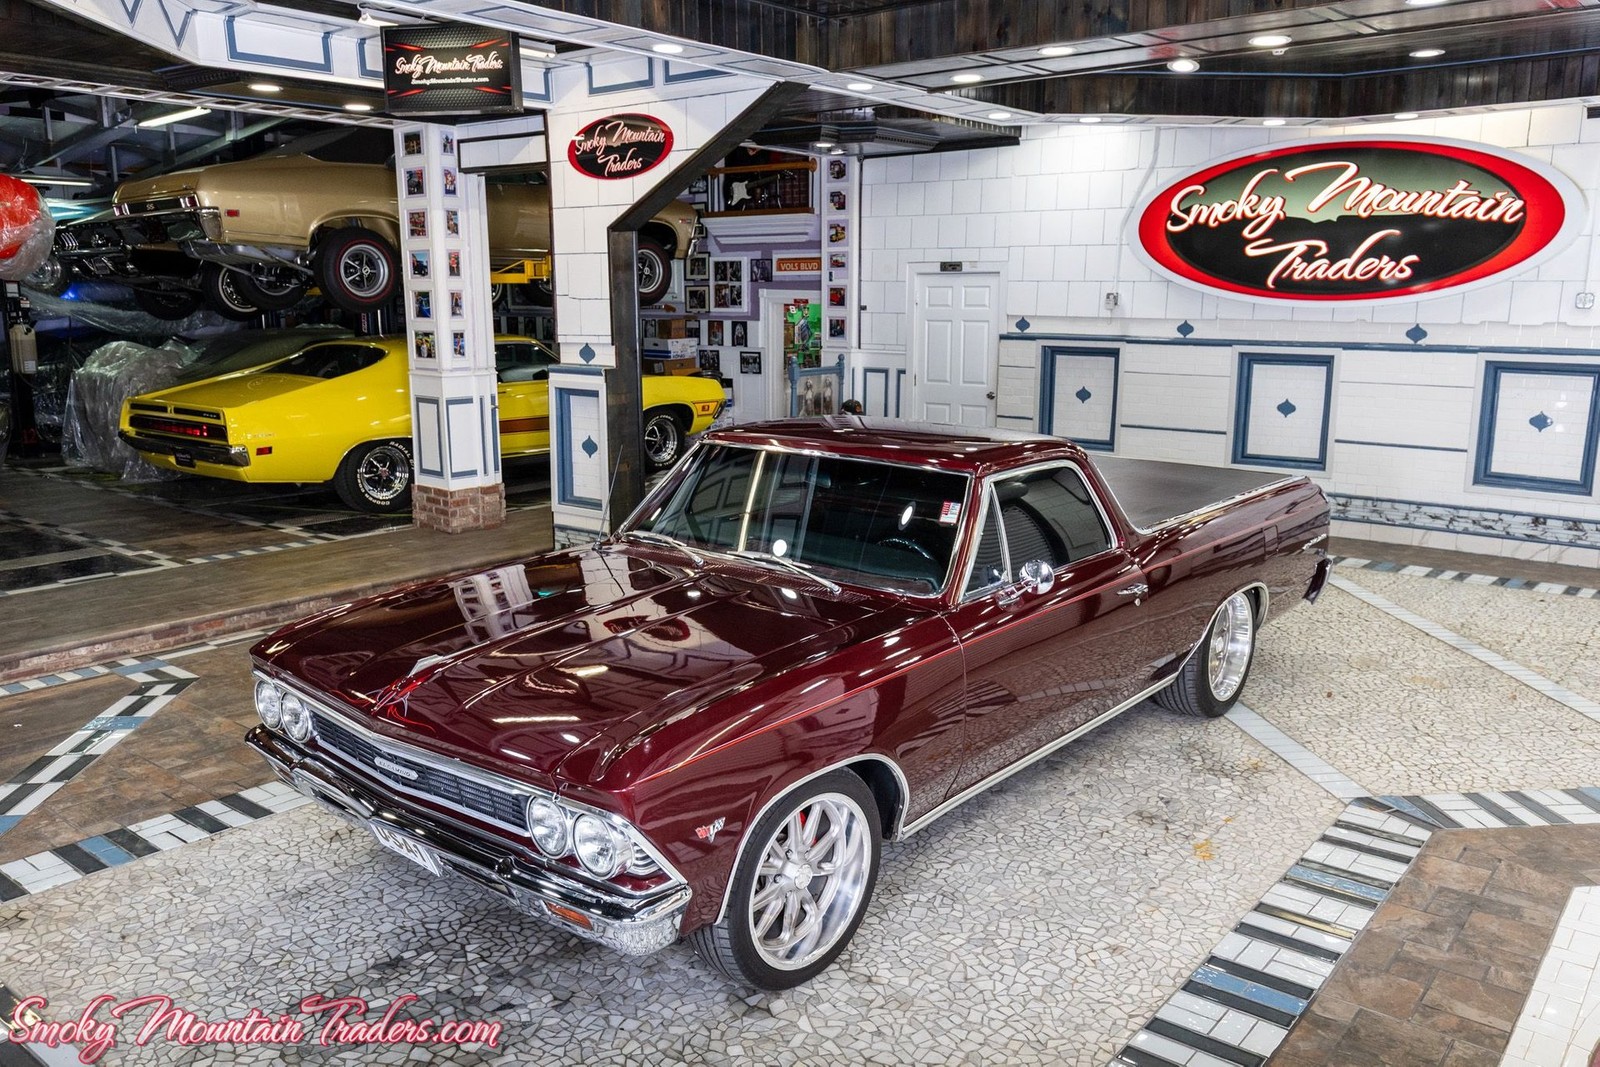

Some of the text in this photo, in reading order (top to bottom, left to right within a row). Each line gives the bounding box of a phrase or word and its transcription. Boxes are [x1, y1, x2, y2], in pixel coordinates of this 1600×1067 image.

[395, 51, 503, 78] Smoky Mountain Traders
[575, 120, 665, 156] Smoky Mountain
[597, 147, 643, 176] Traders
[1166, 160, 1528, 240] Smoky Mountain
[780, 262, 818, 271] VOLS BLVD
[1244, 229, 1421, 289] Traders
